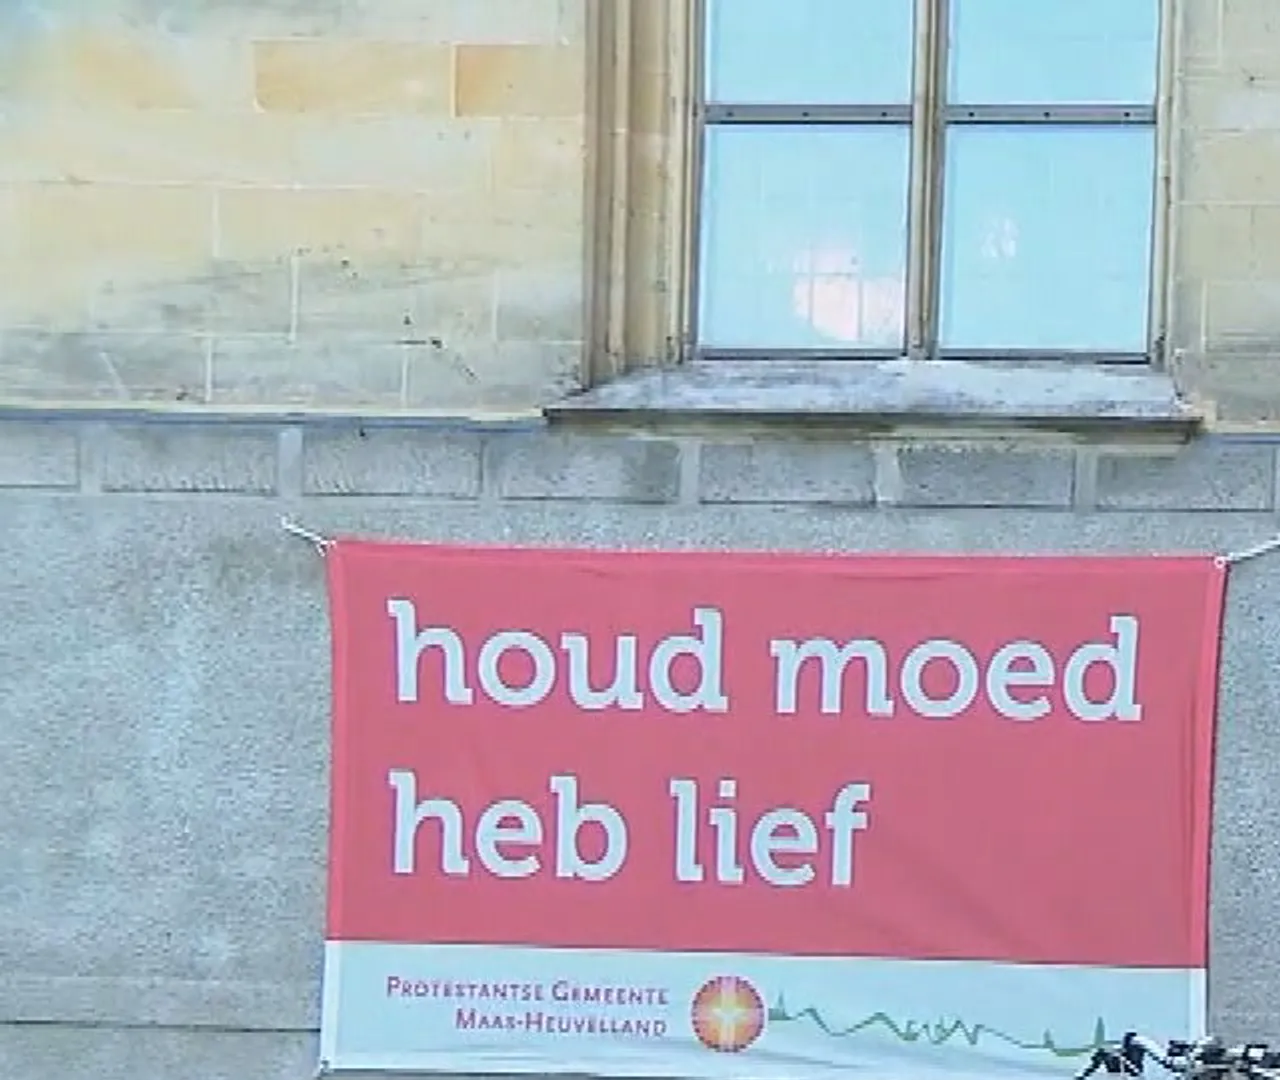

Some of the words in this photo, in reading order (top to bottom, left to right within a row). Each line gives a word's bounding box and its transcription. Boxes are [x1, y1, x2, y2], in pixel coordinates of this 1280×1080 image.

[387, 599, 729, 713] houd
[769, 615, 1142, 722] moed
[388, 768, 628, 880] heb
[669, 778, 871, 887] lief
